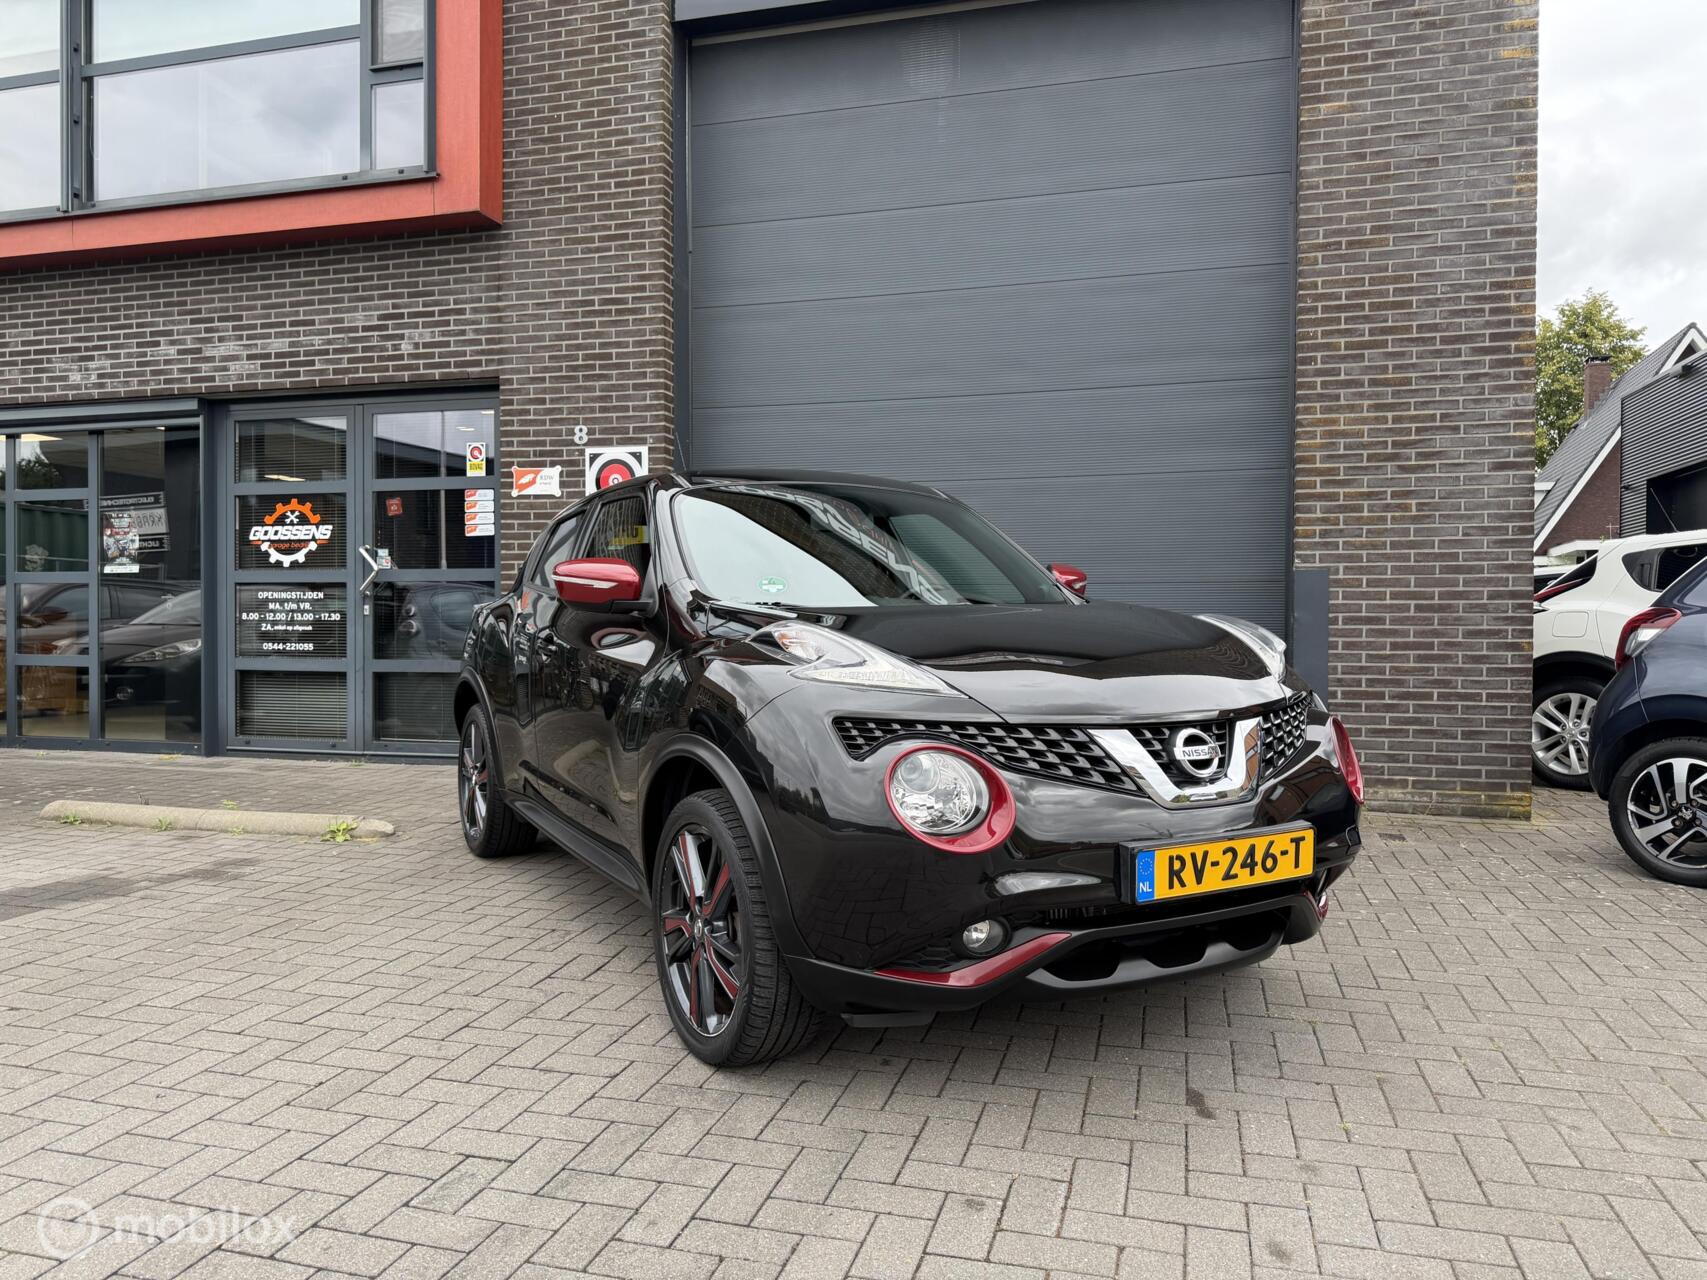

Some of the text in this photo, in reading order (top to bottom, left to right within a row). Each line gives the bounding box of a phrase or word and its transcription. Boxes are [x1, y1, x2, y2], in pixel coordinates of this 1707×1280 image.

[573, 425, 588, 444] 8
[249, 525, 333, 540] GOOSSENS
[269, 602, 312, 610] MA. t/m VR.
[1168, 836, 1306, 890] RV-246-T
[1139, 881, 1152, 893] NL
